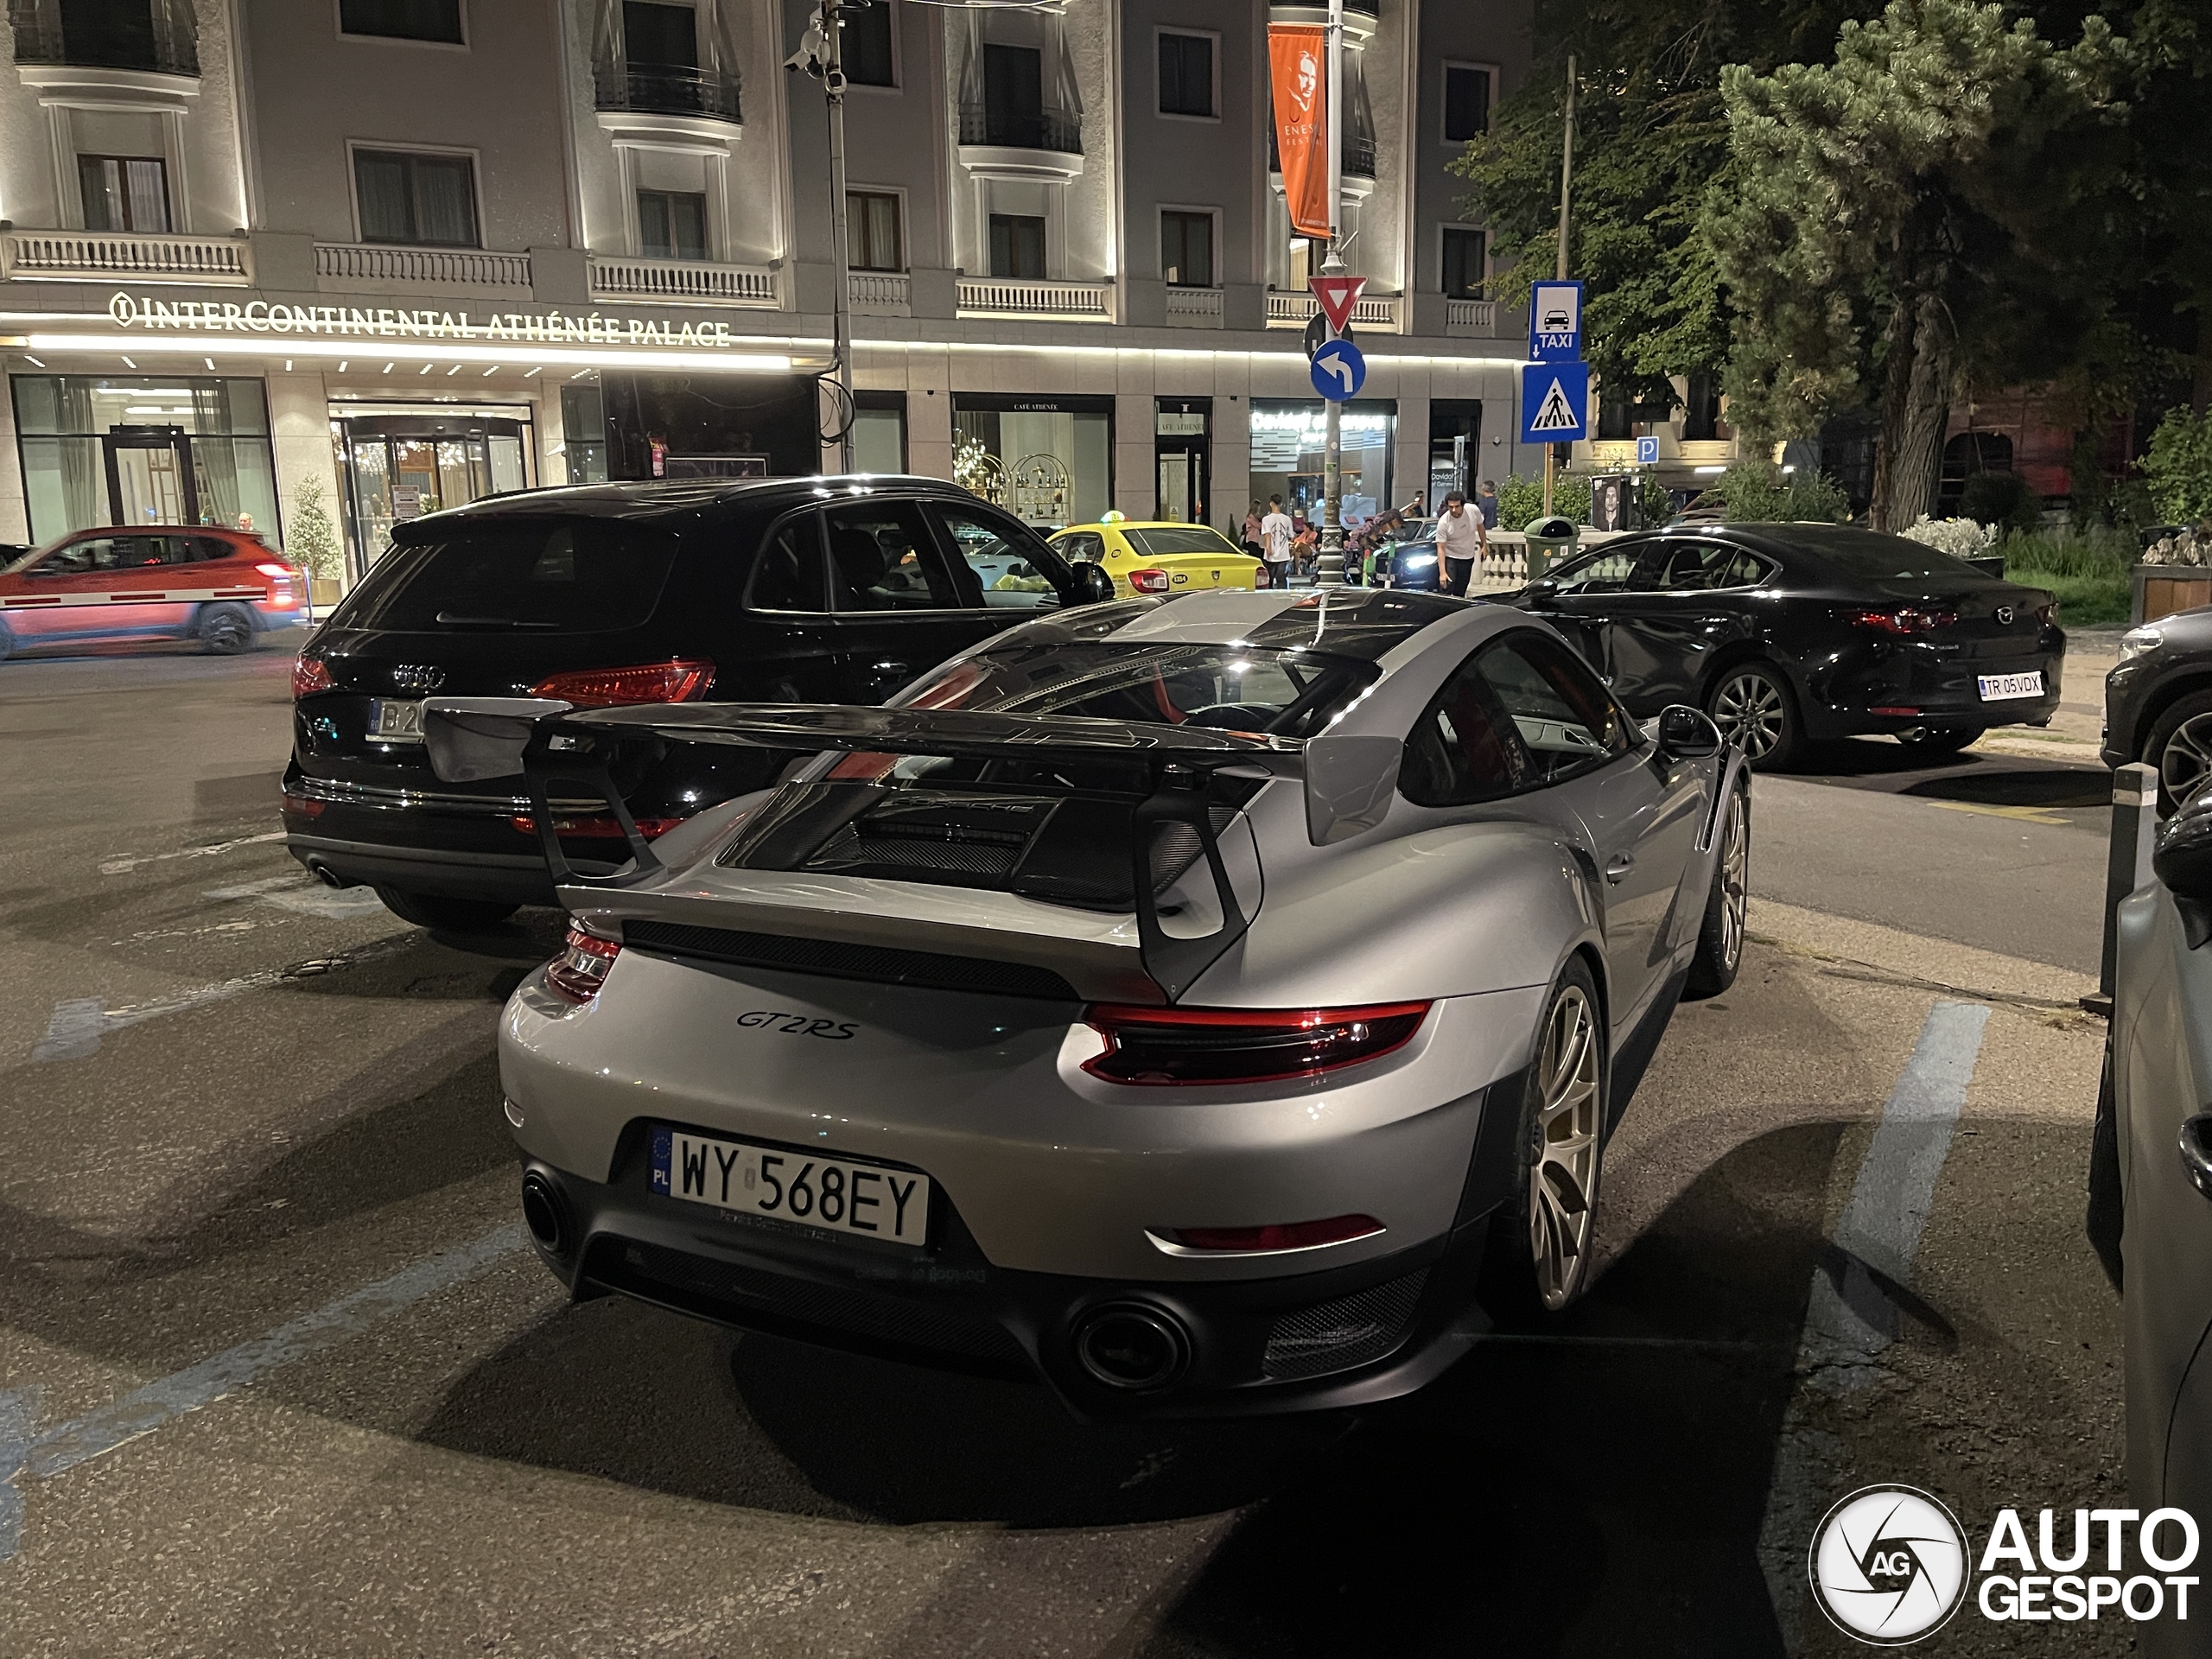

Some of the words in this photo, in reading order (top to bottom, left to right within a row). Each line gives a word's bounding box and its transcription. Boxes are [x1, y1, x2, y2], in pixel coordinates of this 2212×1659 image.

[1284, 123, 1323, 137] ENESU
[1286, 136, 1323, 146] FESTAL
[486, 310, 620, 345] ATHÉNÉE
[627, 319, 731, 347] PALACE
[1539, 334, 1573, 348] TAXI
[1986, 679, 2001, 695] TR
[382, 703, 397, 731] B
[653, 1168, 669, 1186] PL
[682, 1140, 740, 1203] WY
[757, 1154, 917, 1236] 568EY
